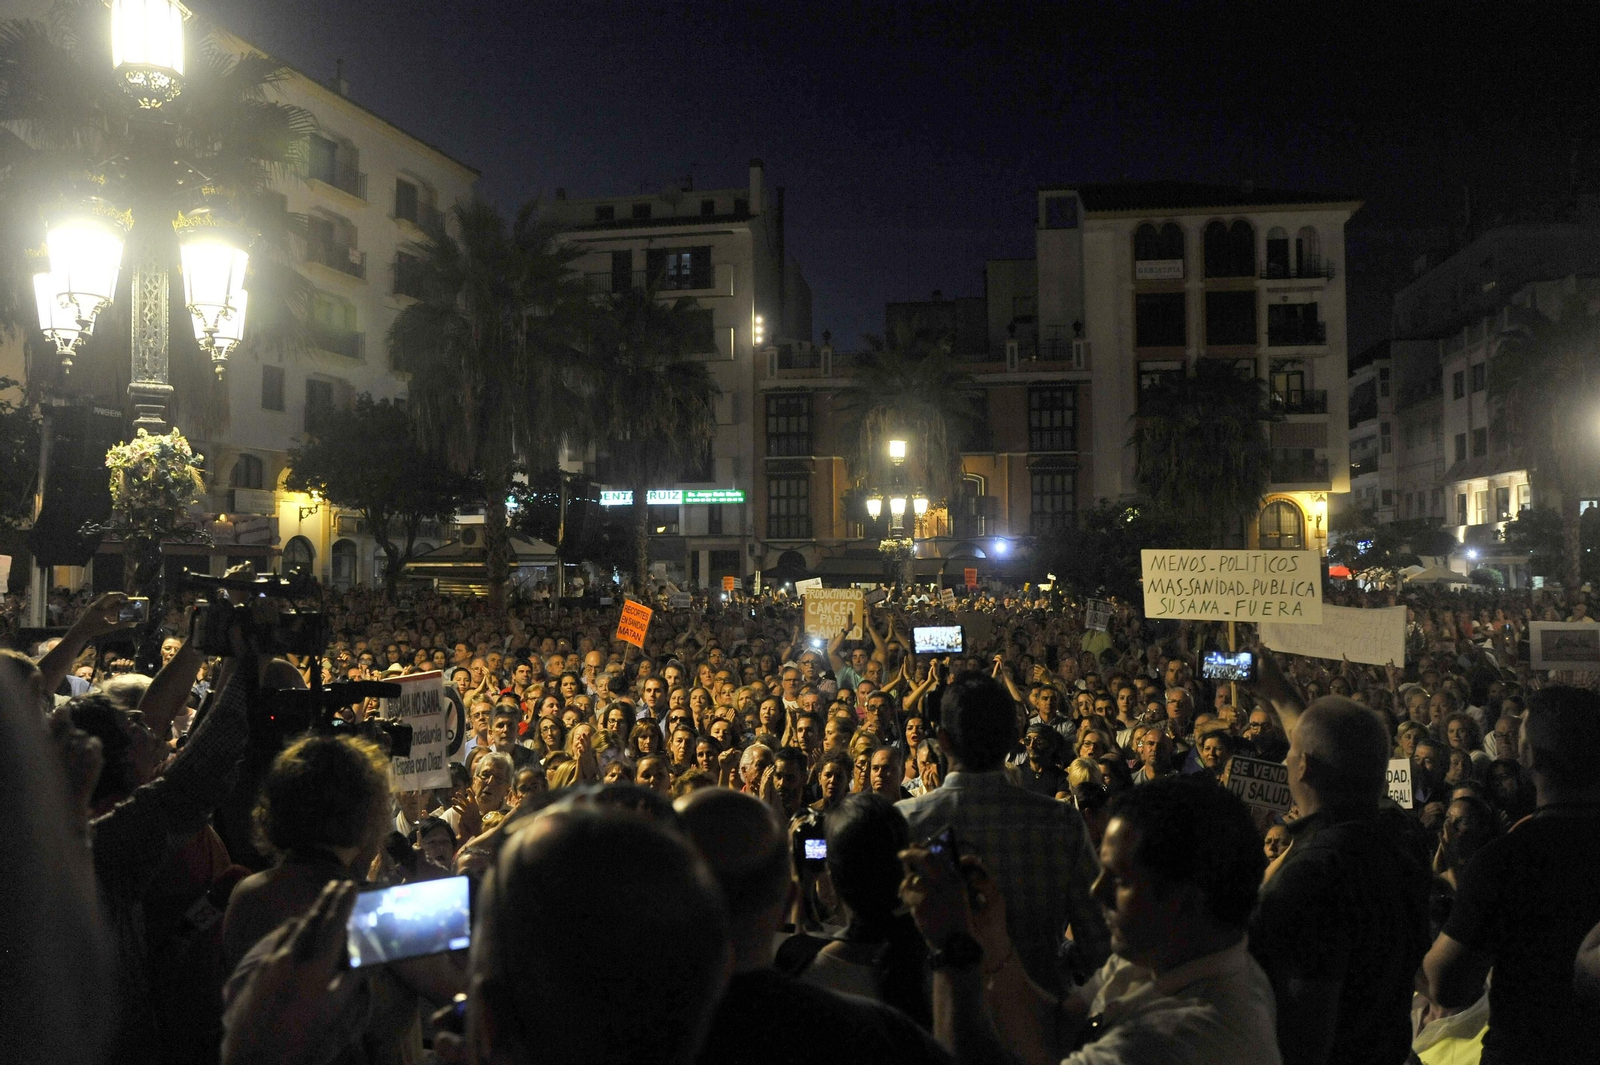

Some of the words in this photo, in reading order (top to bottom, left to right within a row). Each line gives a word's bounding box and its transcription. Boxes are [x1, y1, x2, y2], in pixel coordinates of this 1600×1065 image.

[650, 491, 680, 500] RUIZ
[806, 588, 863, 600] PRODUCTIVIDAD
[621, 615, 628, 624] EN
[624, 604, 649, 621] RECORTES
[415, 757, 427, 773] con
[1232, 760, 1250, 775] SE
[1230, 778, 1246, 797] TU
[1248, 781, 1290, 806] SALUD
